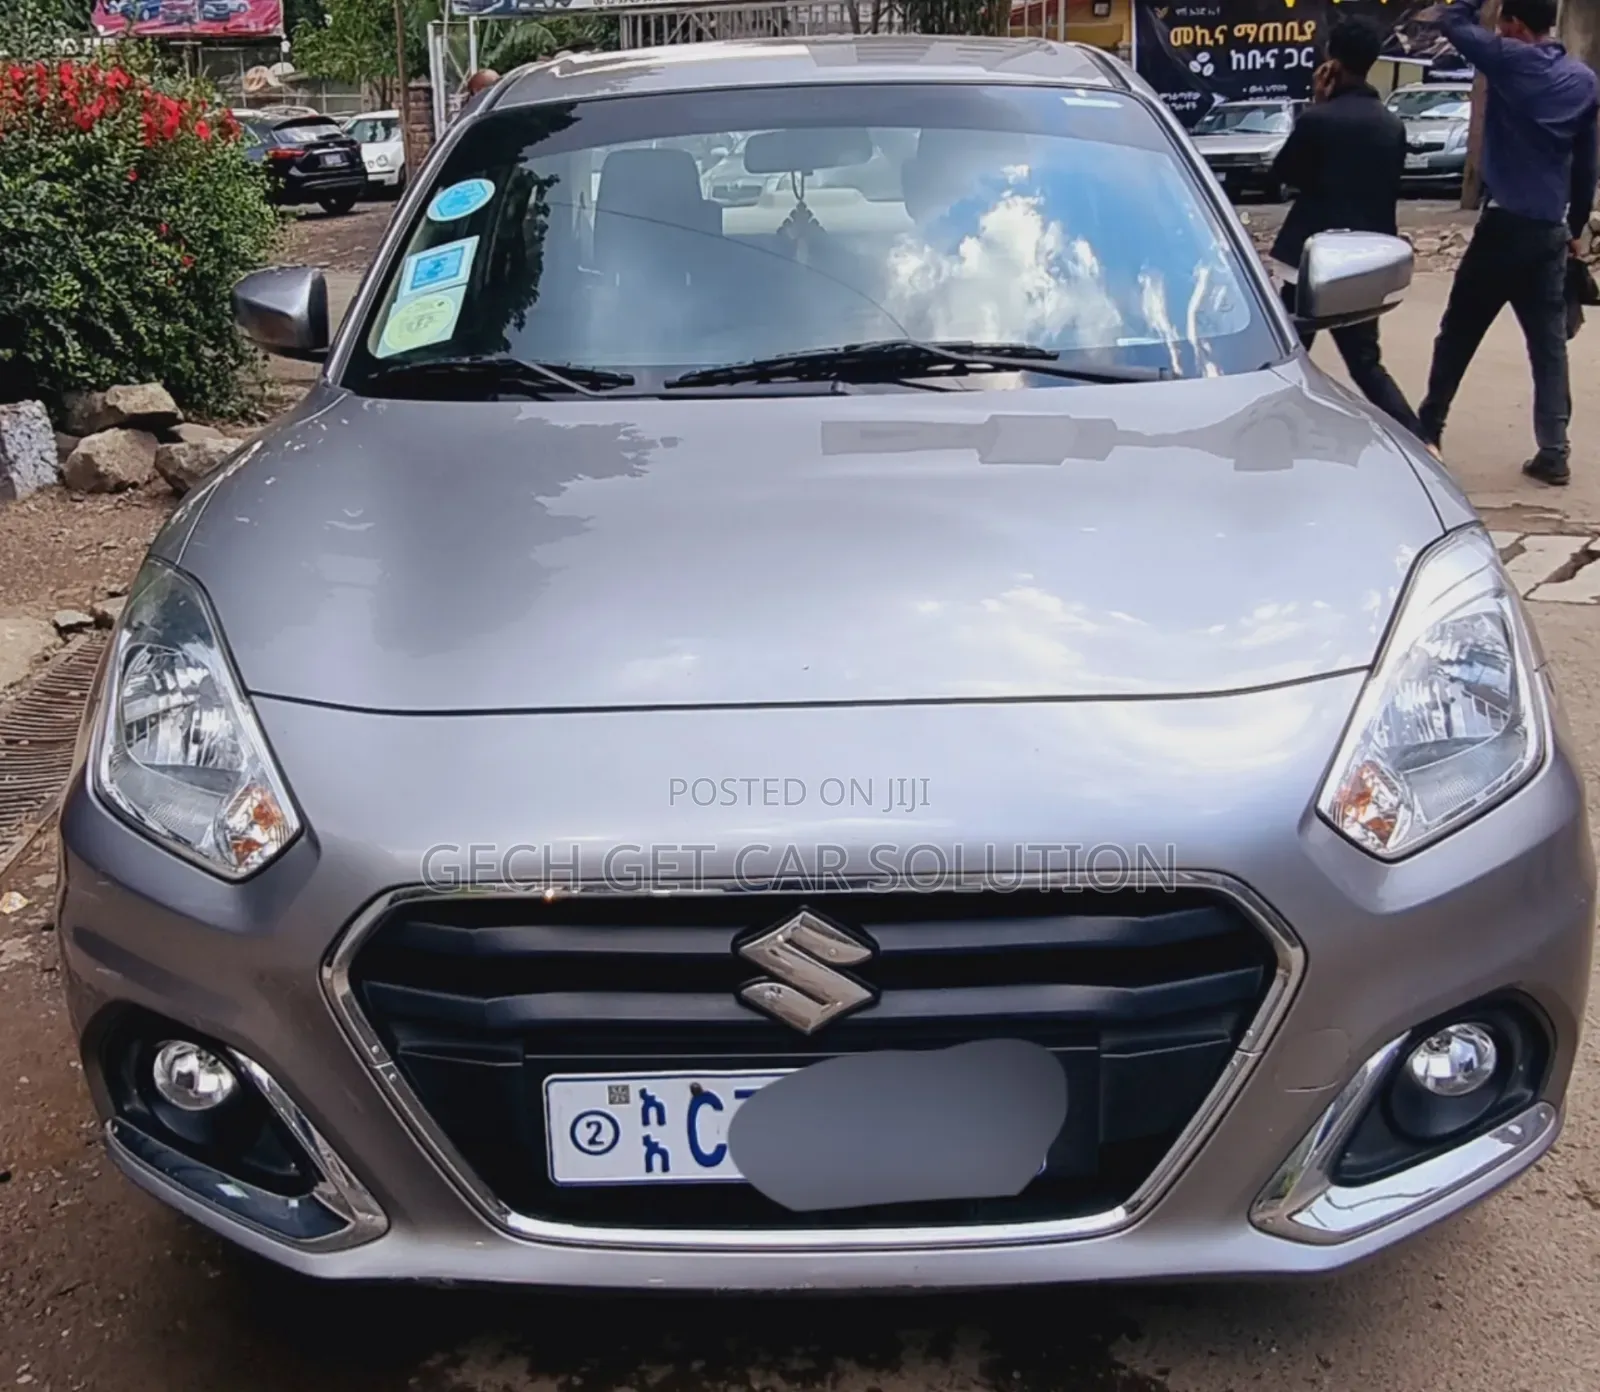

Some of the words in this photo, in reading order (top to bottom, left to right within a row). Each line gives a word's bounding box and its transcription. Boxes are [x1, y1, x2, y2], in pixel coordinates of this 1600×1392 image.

[1169, 24, 1228, 47] መኪና
[1233, 19, 1317, 44] ማጠቢያ
[1230, 47, 1279, 71] ከቡና
[1283, 46, 1315, 70] ጋር
